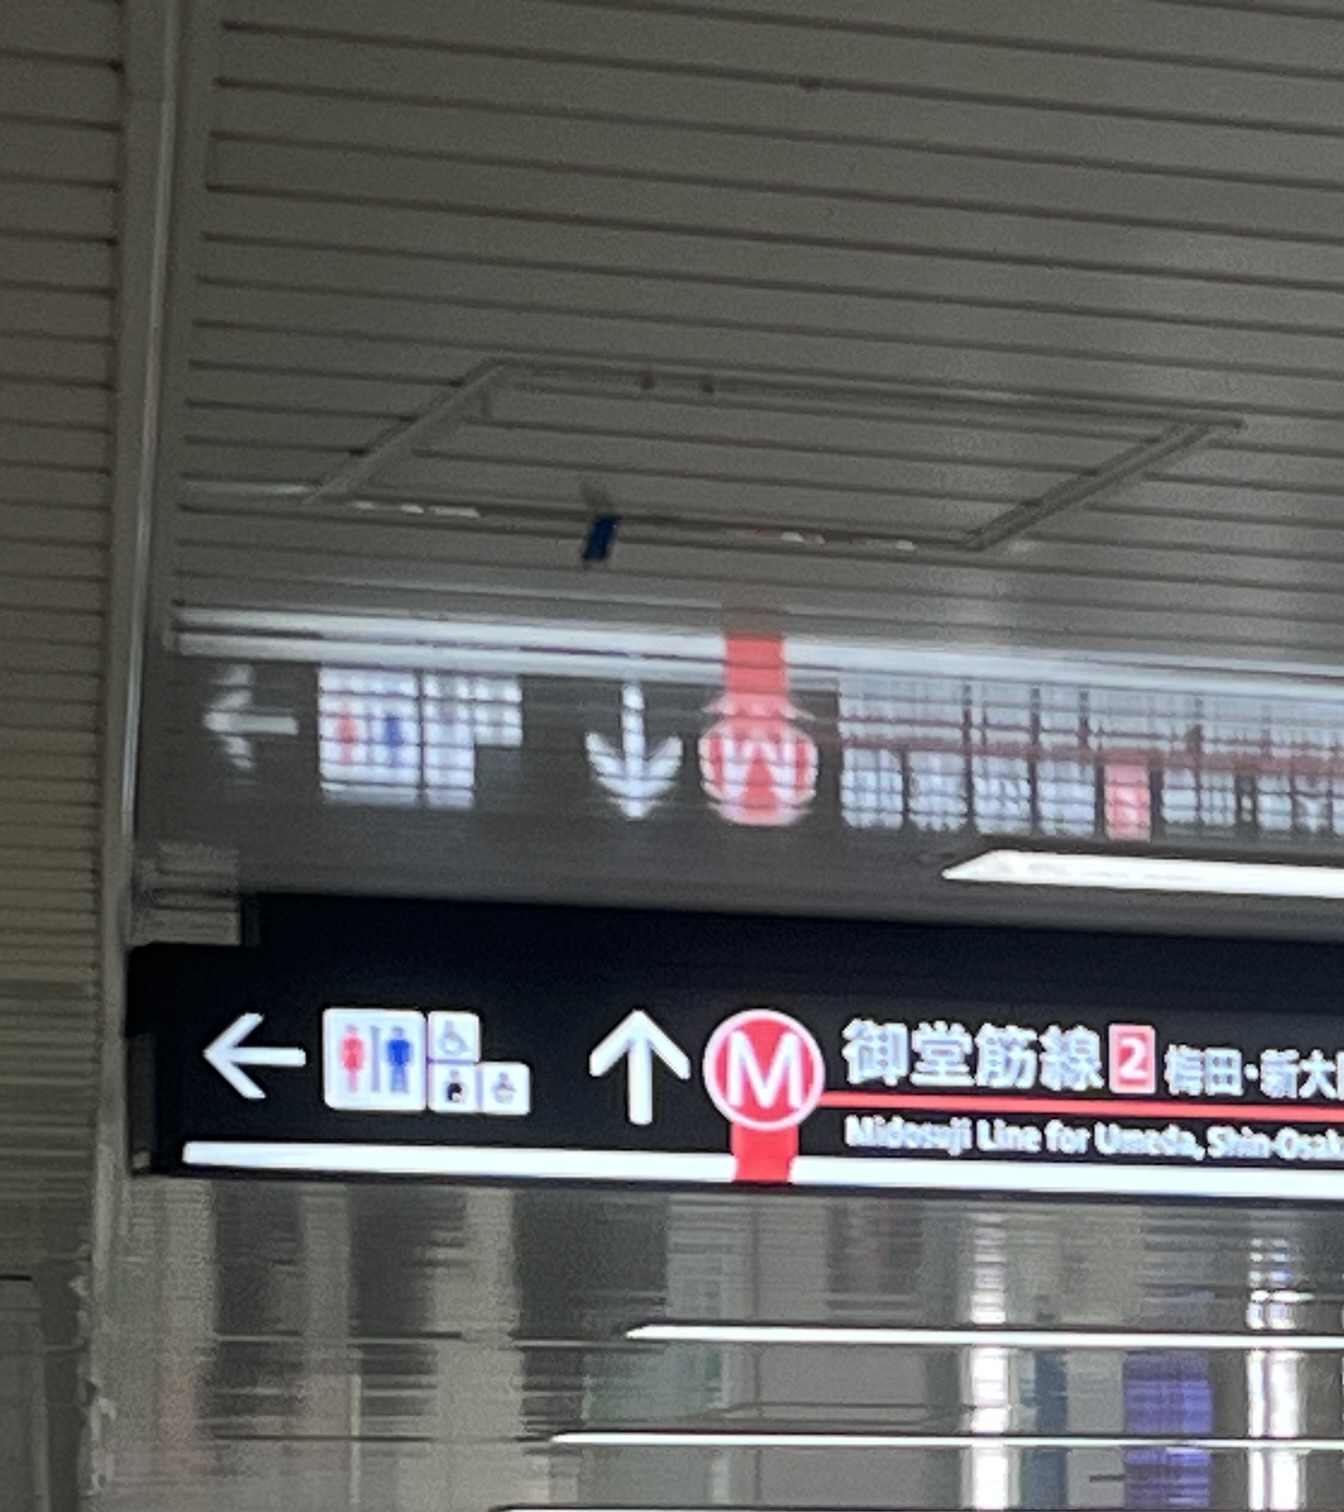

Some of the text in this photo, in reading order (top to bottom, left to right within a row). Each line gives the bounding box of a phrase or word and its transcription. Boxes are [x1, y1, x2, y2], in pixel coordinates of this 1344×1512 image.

[725, 1029, 804, 1109] M
[842, 1017, 1104, 1091] 御堂筋線
[976, 1118, 1042, 1152] Line
[1044, 1118, 1091, 1154] for
